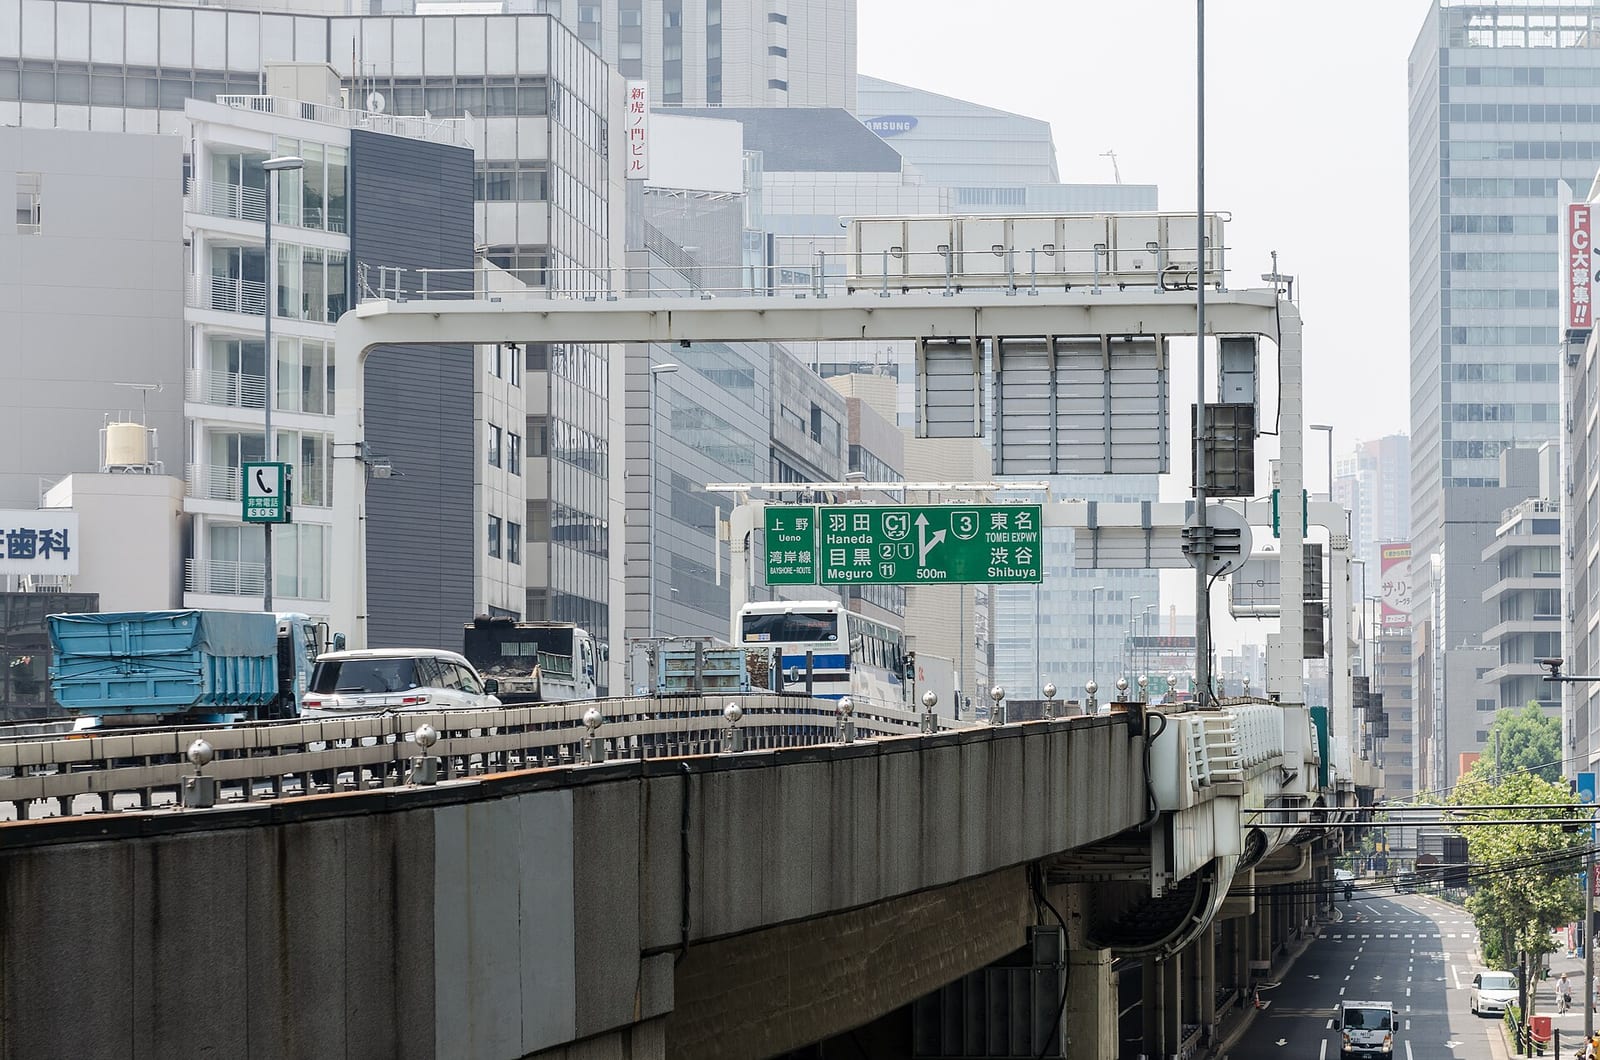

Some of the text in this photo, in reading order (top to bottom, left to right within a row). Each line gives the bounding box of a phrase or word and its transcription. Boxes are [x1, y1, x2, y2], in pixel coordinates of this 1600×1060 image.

[630, 87, 645, 171] 新虎ノ門ビル
[864, 121, 910, 131] AMSUNG
[248, 498, 279, 508] 非常電話
[251, 508, 275, 517] SOS
[771, 517, 809, 531] 上野
[829, 513, 870, 532] 羽田
[885, 515, 907, 531] C1
[960, 516, 972, 532] 3
[990, 511, 1032, 530] 東名
[778, 534, 801, 542] Ueno
[826, 533, 873, 544] Haneda
[985, 532, 1037, 543] TOMEI EXPWY
[769, 550, 811, 564] 湾岸線
[882, 545, 892, 557] 2
[902, 545, 909, 557] 1
[990, 546, 1033, 565] 渋谷
[830, 548, 872, 567] 目黒
[827, 568, 873, 580] Meguro
[881, 564, 893, 576] 11
[916, 568, 947, 579] 500m
[987, 567, 1037, 579] Shibuya
